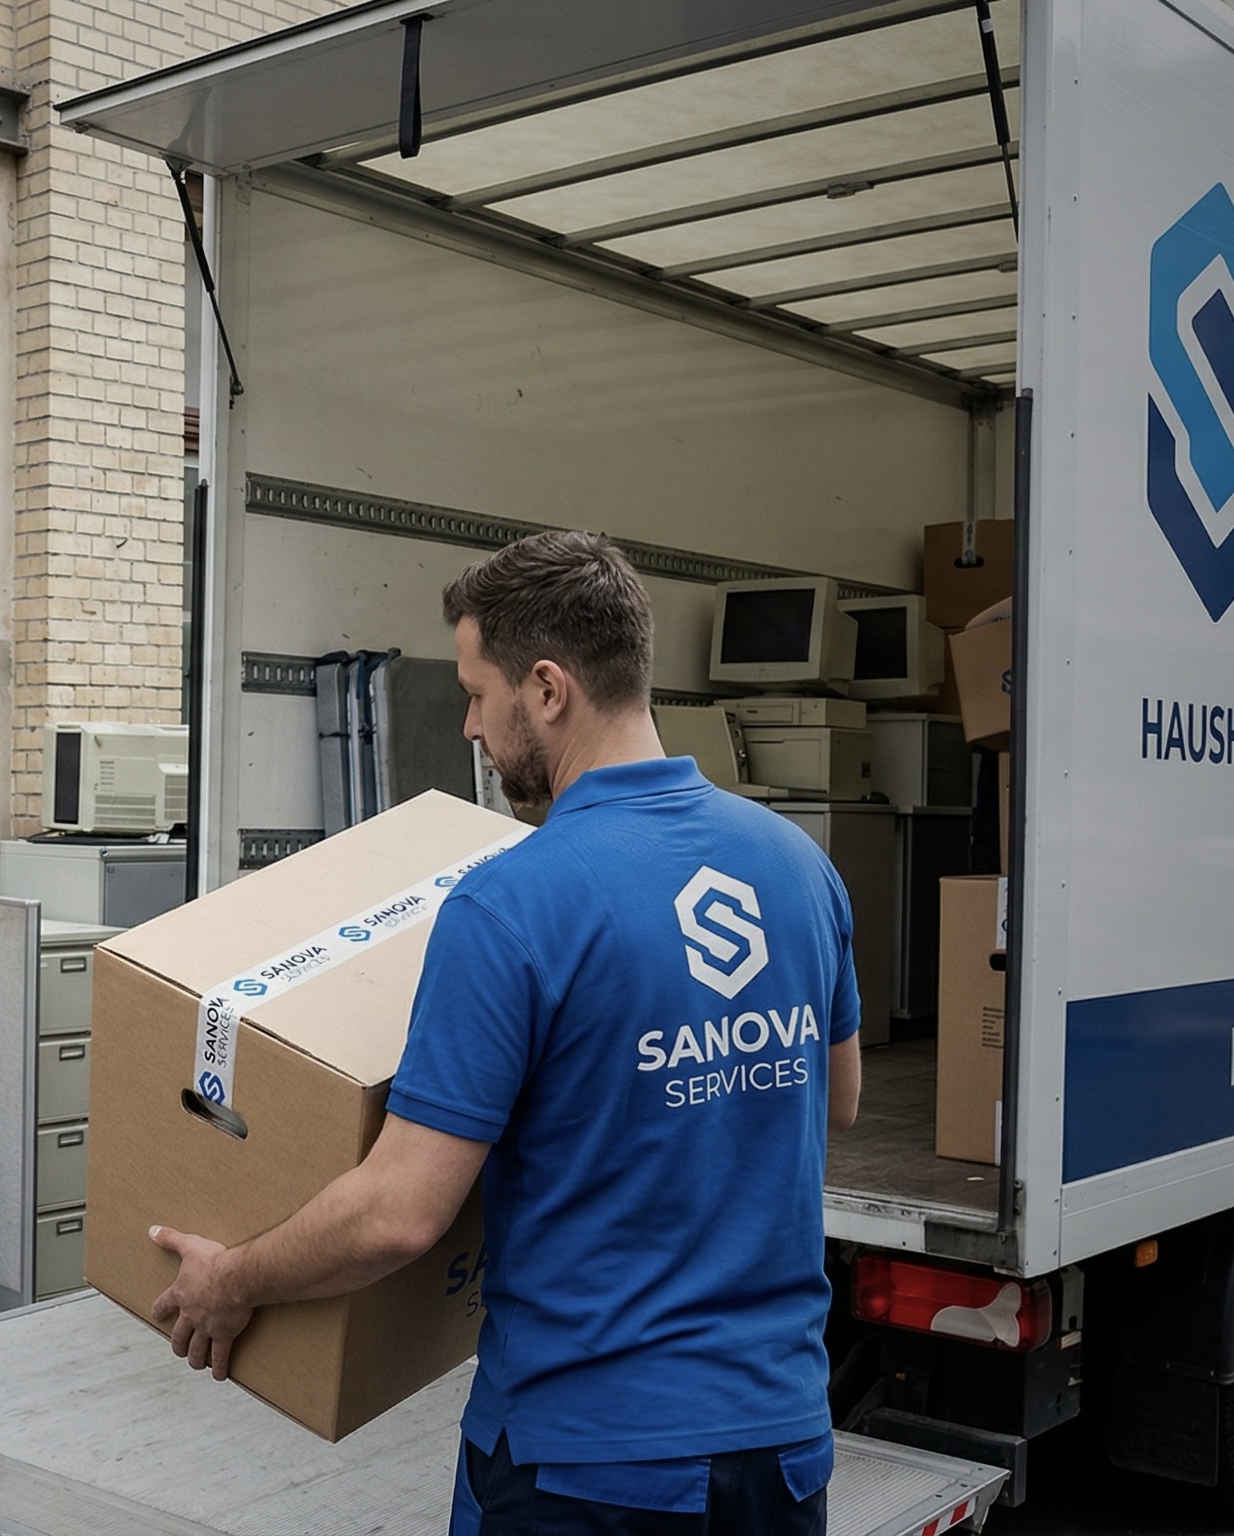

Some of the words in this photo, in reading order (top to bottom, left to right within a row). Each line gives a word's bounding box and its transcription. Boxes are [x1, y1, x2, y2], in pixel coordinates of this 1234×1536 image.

[260, 946, 327, 979] SANOVA
[637, 1003, 820, 1071] SANOVA
[665, 1057, 809, 1108] SERVICES
